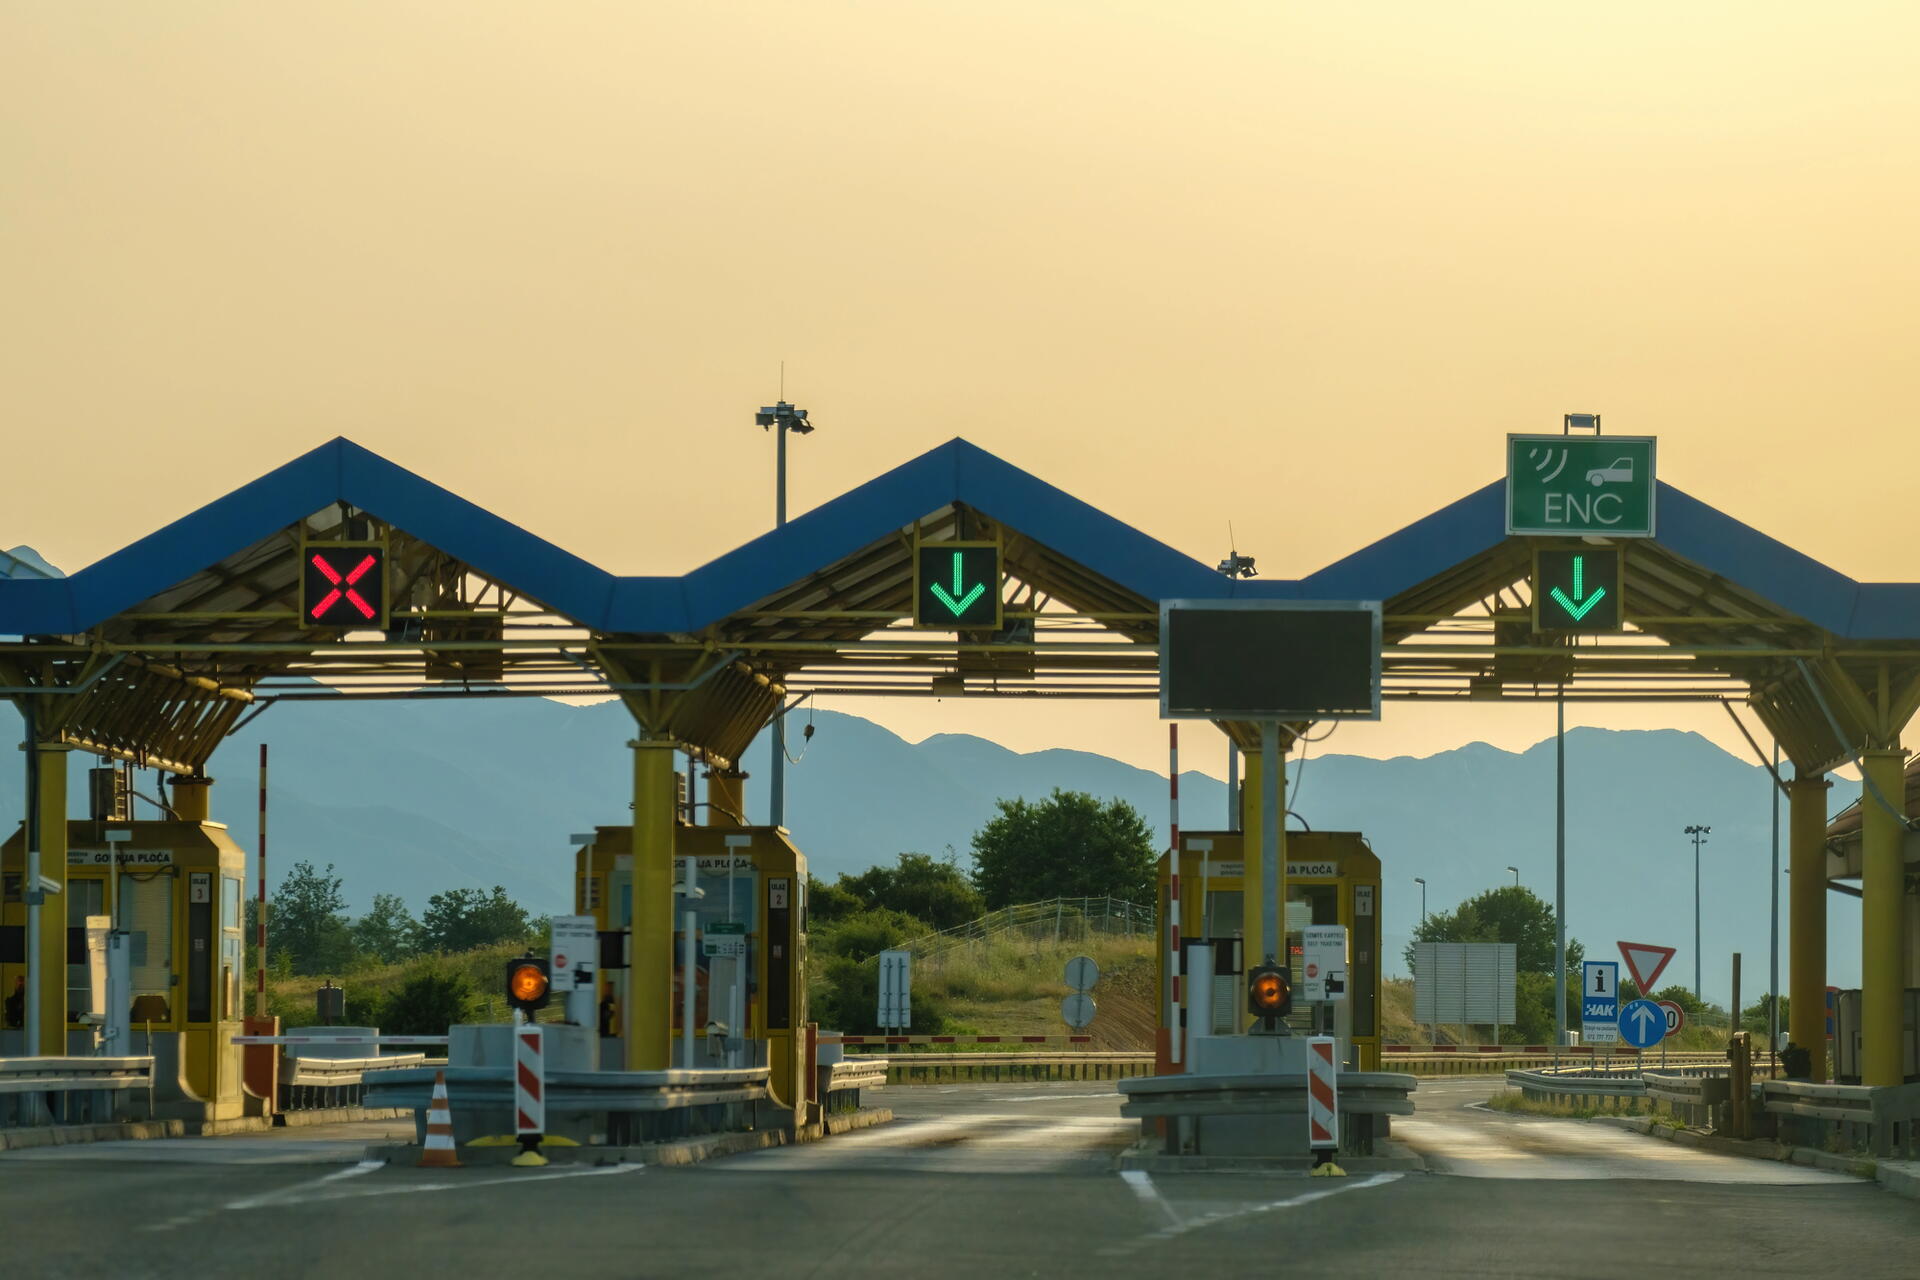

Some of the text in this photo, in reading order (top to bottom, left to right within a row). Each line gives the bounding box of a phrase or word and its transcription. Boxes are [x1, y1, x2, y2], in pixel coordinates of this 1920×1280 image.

[1544, 493, 1623, 524] ENC
[94, 853, 134, 863] GONJA
[776, 894, 782, 905] 2
[1361, 901, 1367, 912] 1
